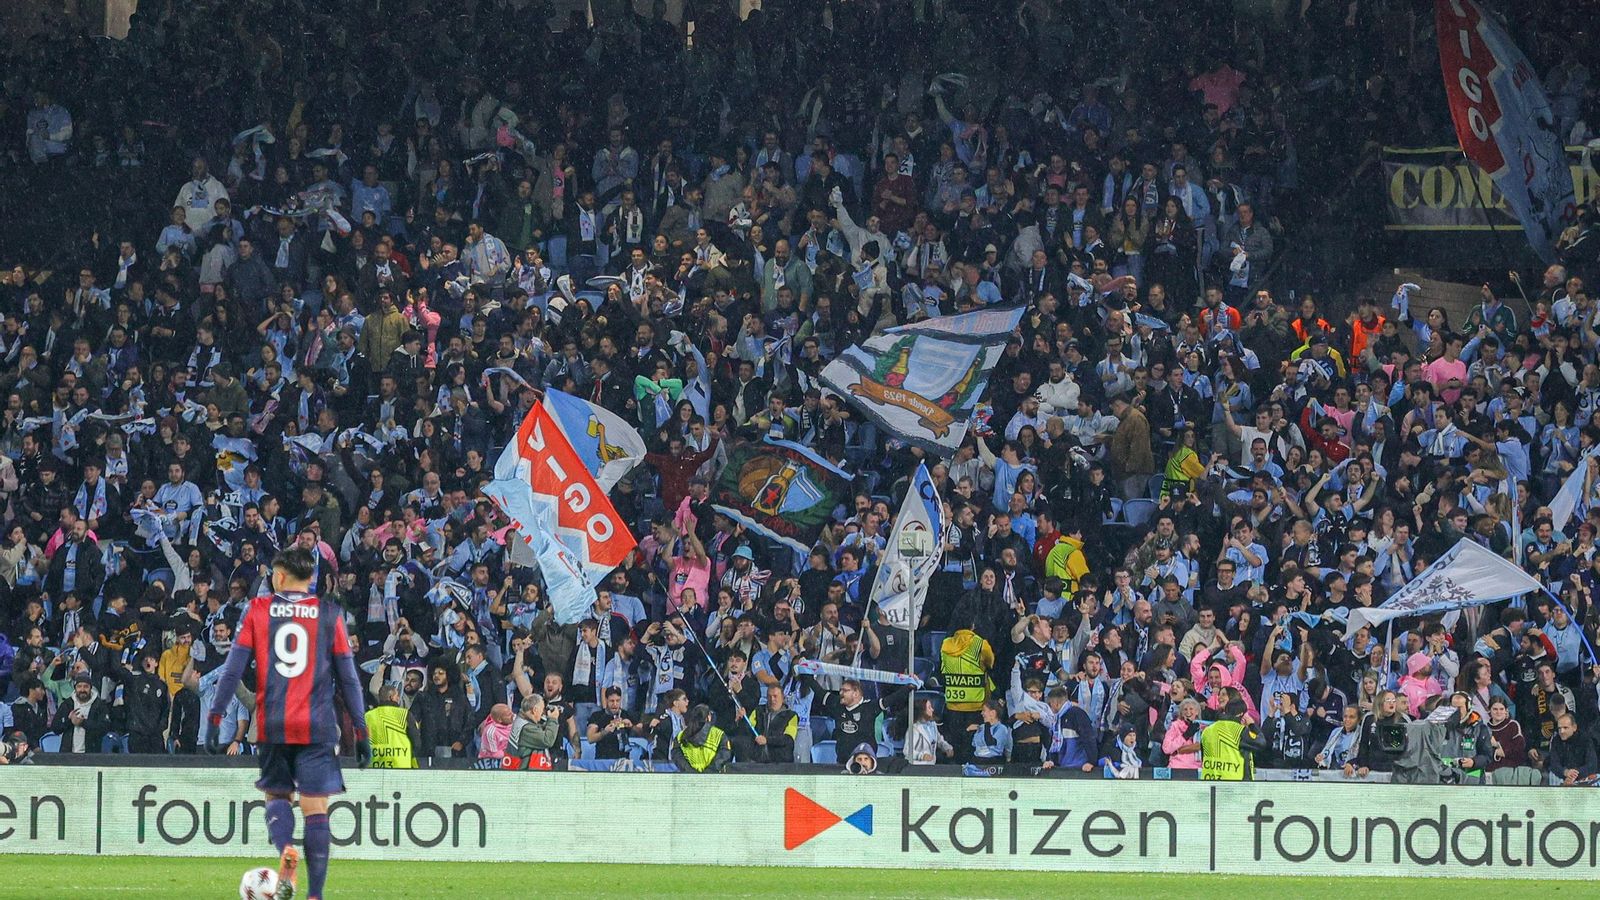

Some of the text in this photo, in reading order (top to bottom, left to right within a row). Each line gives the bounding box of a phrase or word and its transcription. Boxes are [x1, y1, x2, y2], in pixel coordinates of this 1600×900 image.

[269, 603, 319, 619] CASTRO
[274, 622, 309, 679] 9
[945, 689, 966, 700] 039
[372, 747, 408, 757] CURITY
[1203, 760, 1240, 772] CURITY
[132, 784, 487, 849] founation
[901, 788, 1178, 858] kaizen
